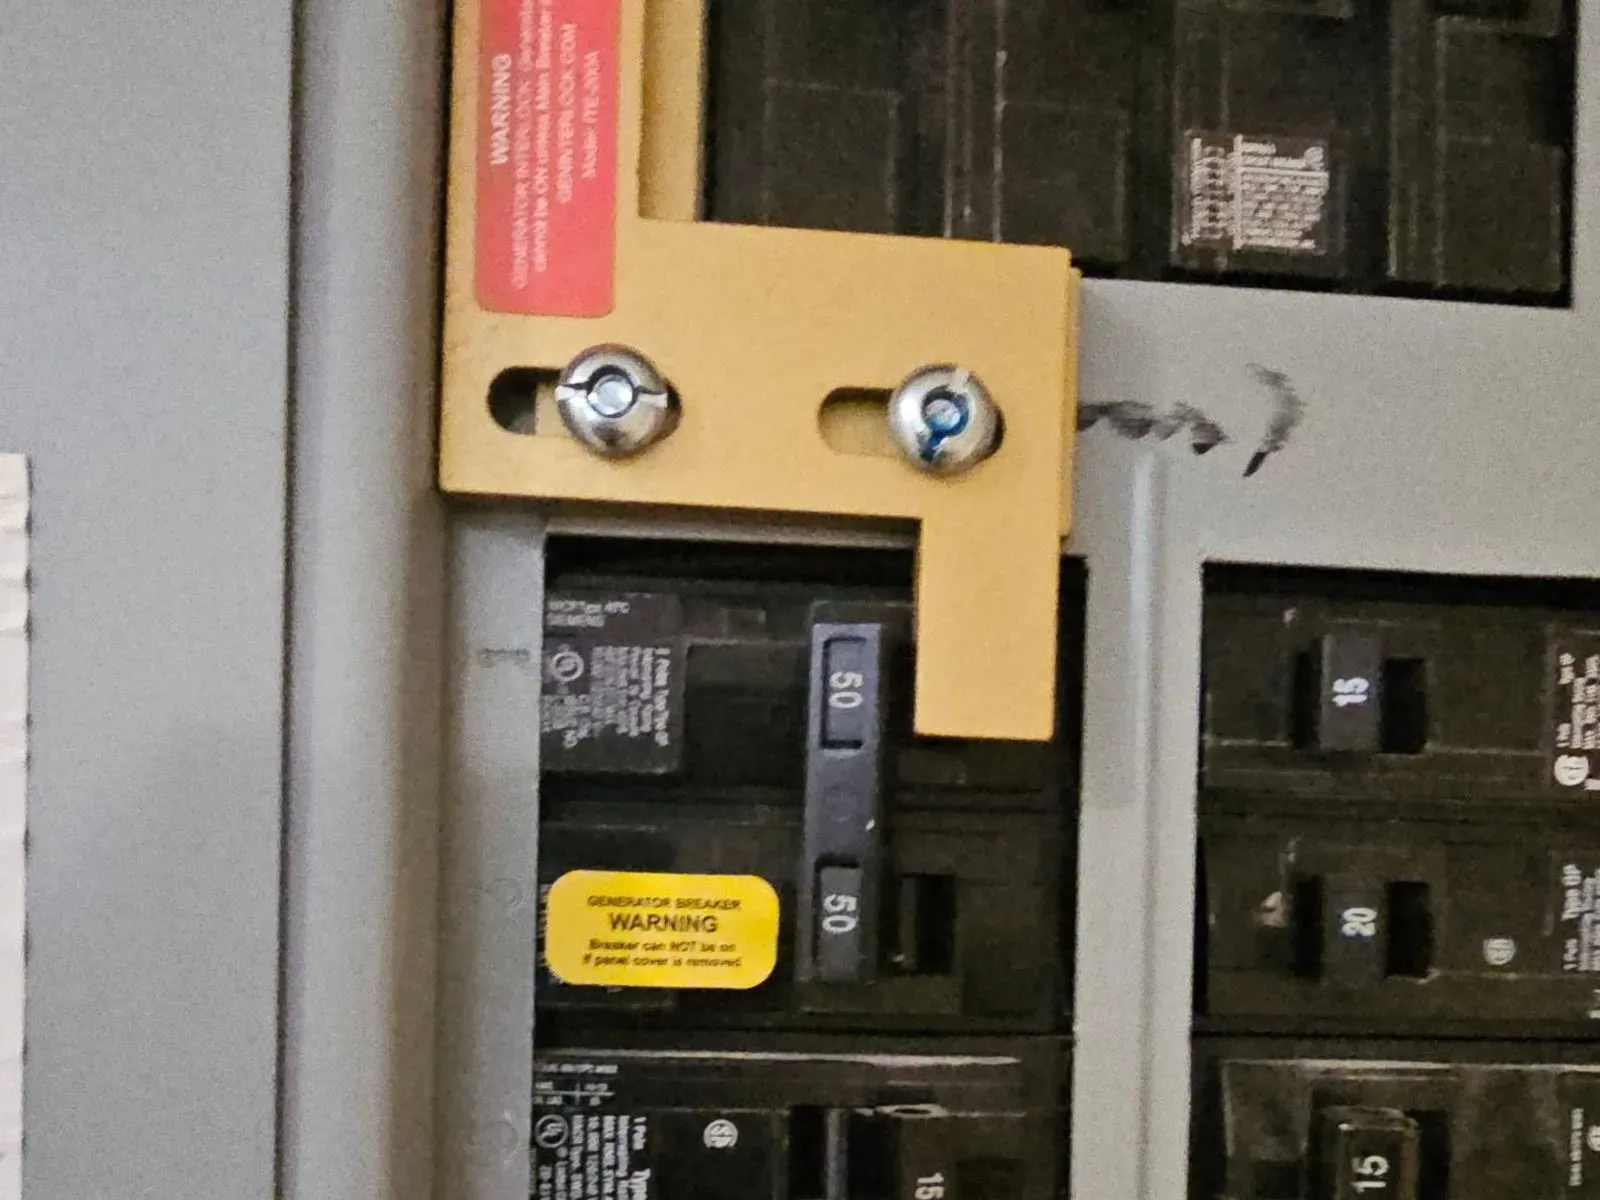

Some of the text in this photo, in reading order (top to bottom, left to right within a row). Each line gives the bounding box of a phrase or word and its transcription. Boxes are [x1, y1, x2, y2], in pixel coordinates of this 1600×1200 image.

[535, 10, 552, 69] Breaker
[535, 71, 550, 111] Main
[490, 54, 512, 165] WARNING
[533, 167, 550, 195] ON
[511, 182, 530, 289] GENERATOR
[828, 671, 864, 709] 50
[1332, 677, 1369, 707] 15
[587, 895, 741, 911] GENERATOR BREAKER
[821, 894, 858, 934] 50
[610, 912, 718, 933] WARNING
[1341, 907, 1378, 936] 20
[588, 938, 736, 952] Breaker can NOT be on
[594, 954, 630, 967] panel
[633, 956, 668, 966] cover
[671, 956, 682, 966] is
[686, 956, 742, 967] removed
[915, 1172, 945, 1200] 15
[1352, 1155, 1390, 1193] 15
